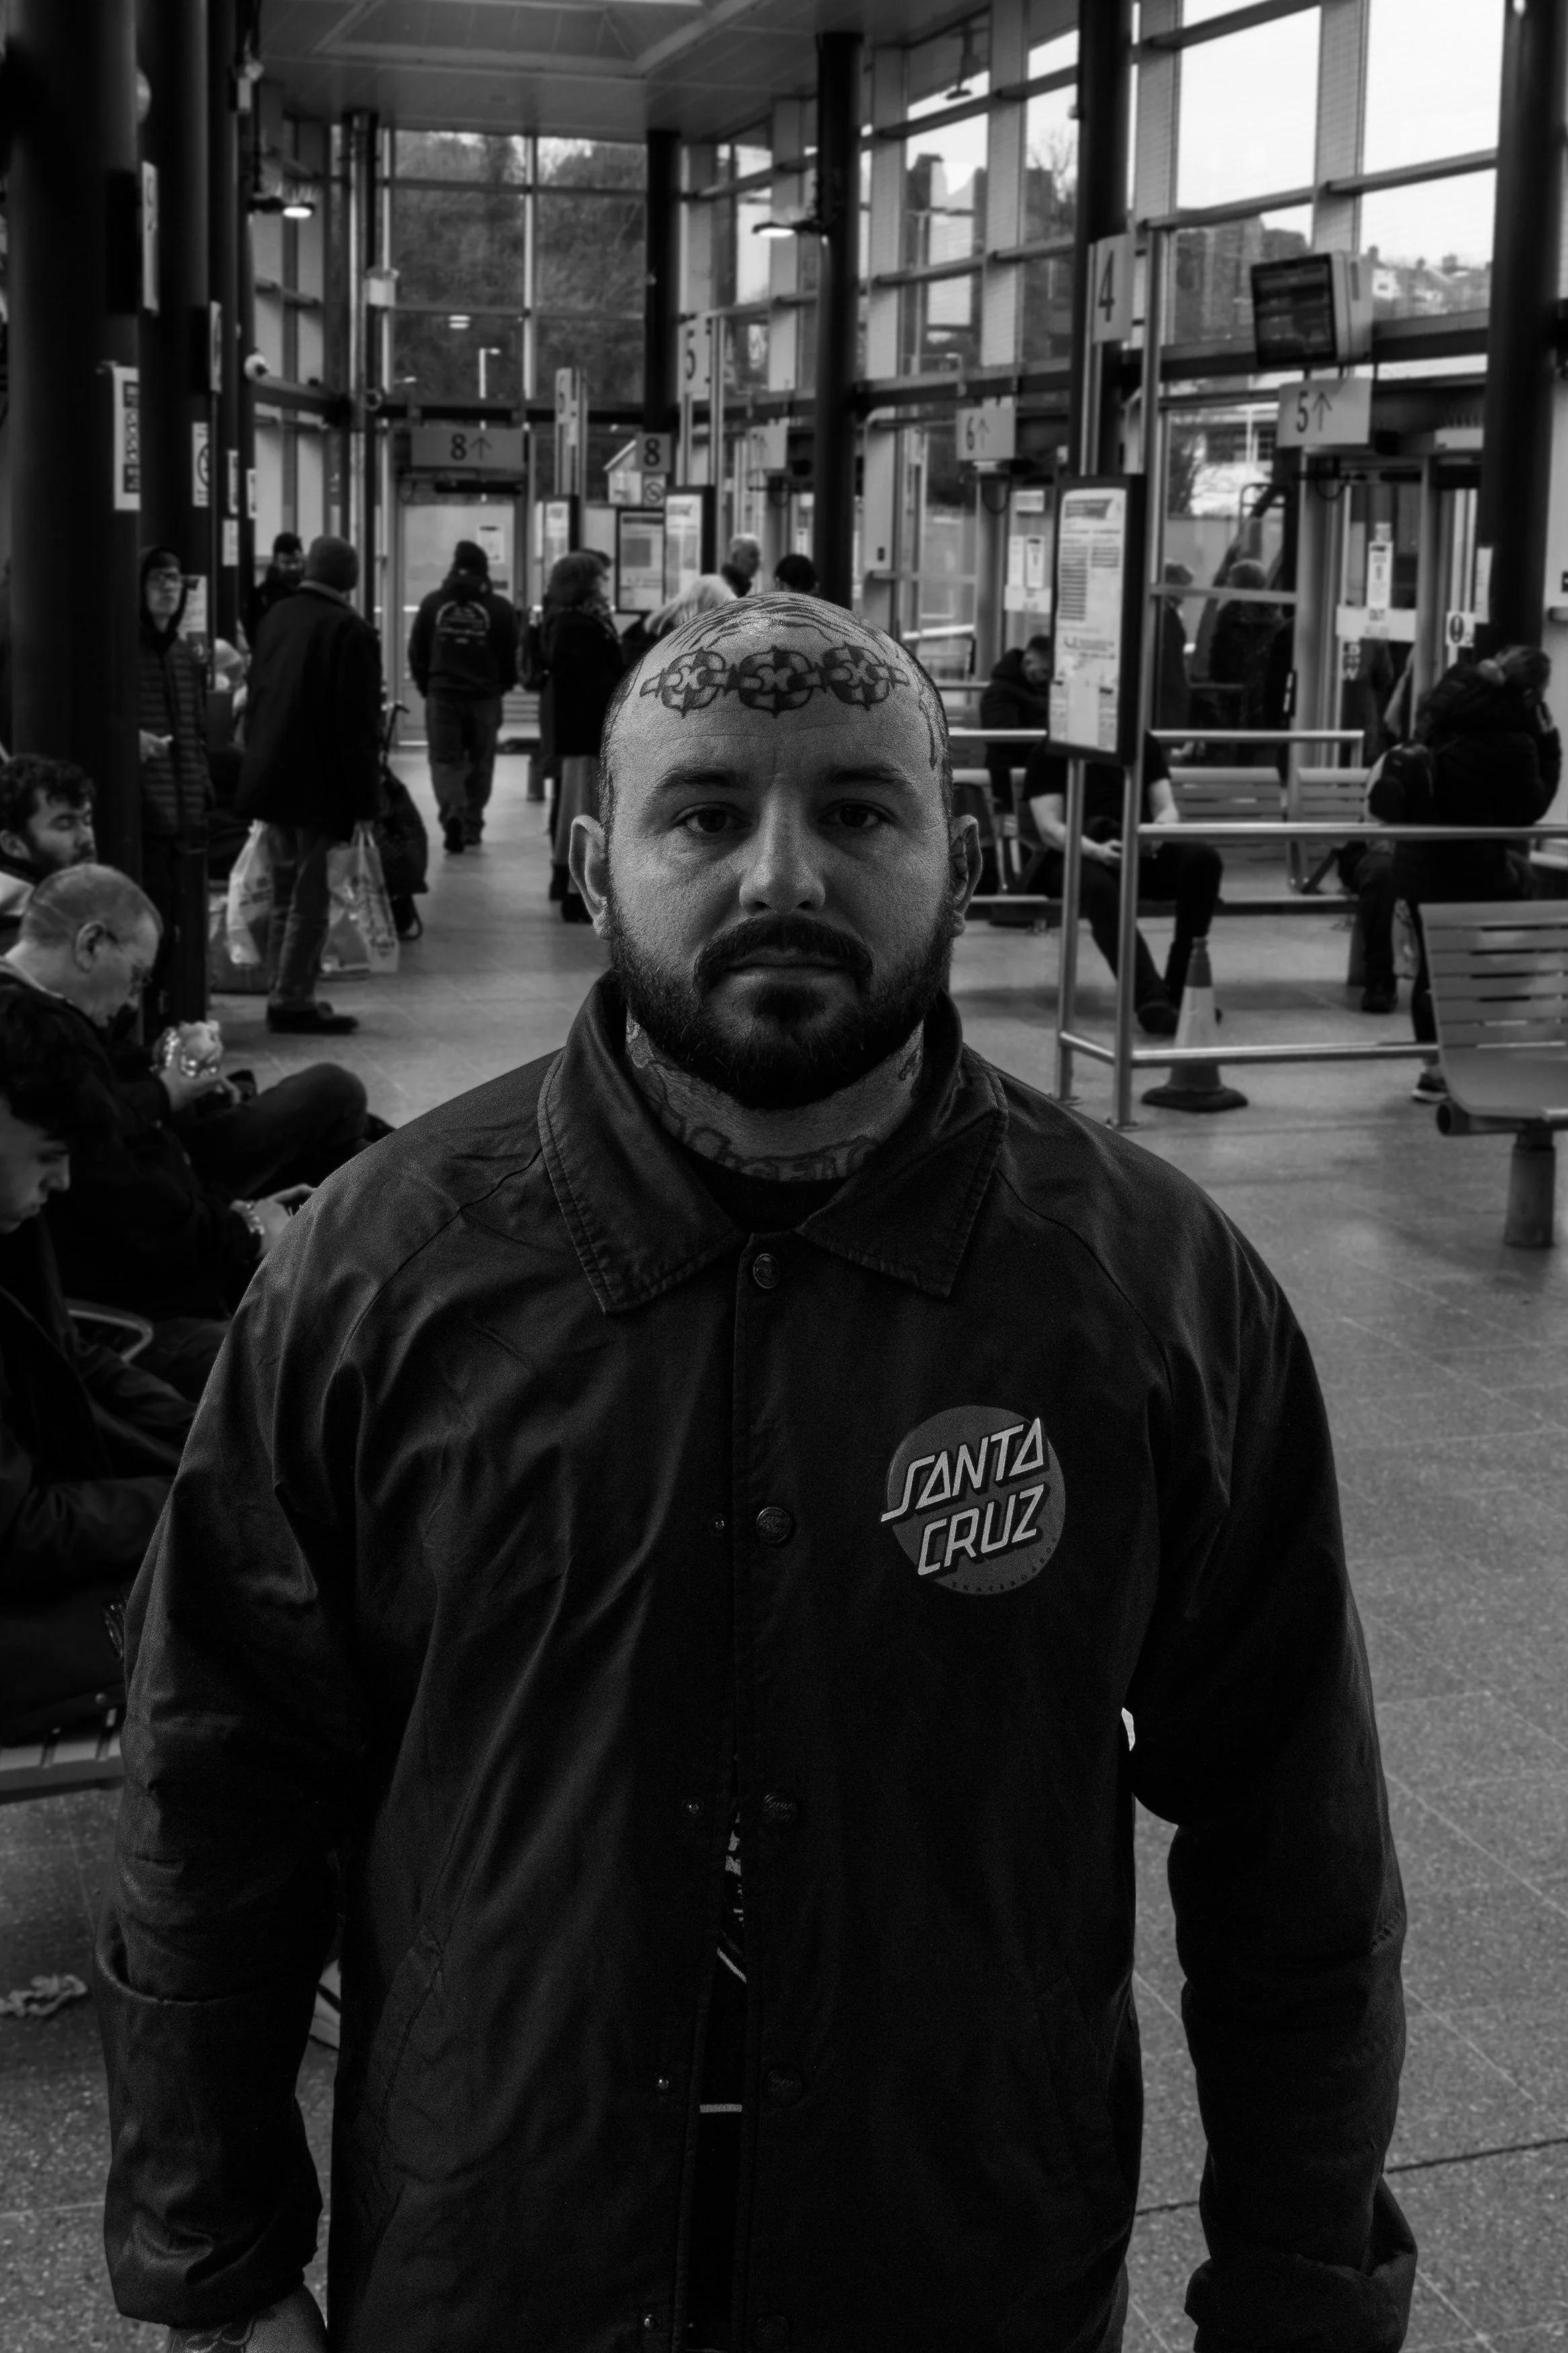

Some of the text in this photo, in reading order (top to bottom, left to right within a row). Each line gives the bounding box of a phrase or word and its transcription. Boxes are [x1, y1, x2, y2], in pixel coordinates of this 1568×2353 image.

[1098, 251, 1115, 323] 4
[966, 416, 975, 451] 6
[1296, 390, 1309, 434] 5
[450, 433, 467, 461] 8
[643, 437, 661, 467] 8
[880, 1417, 1044, 1523] SANTA
[917, 1483, 1045, 1576] CRUZ
